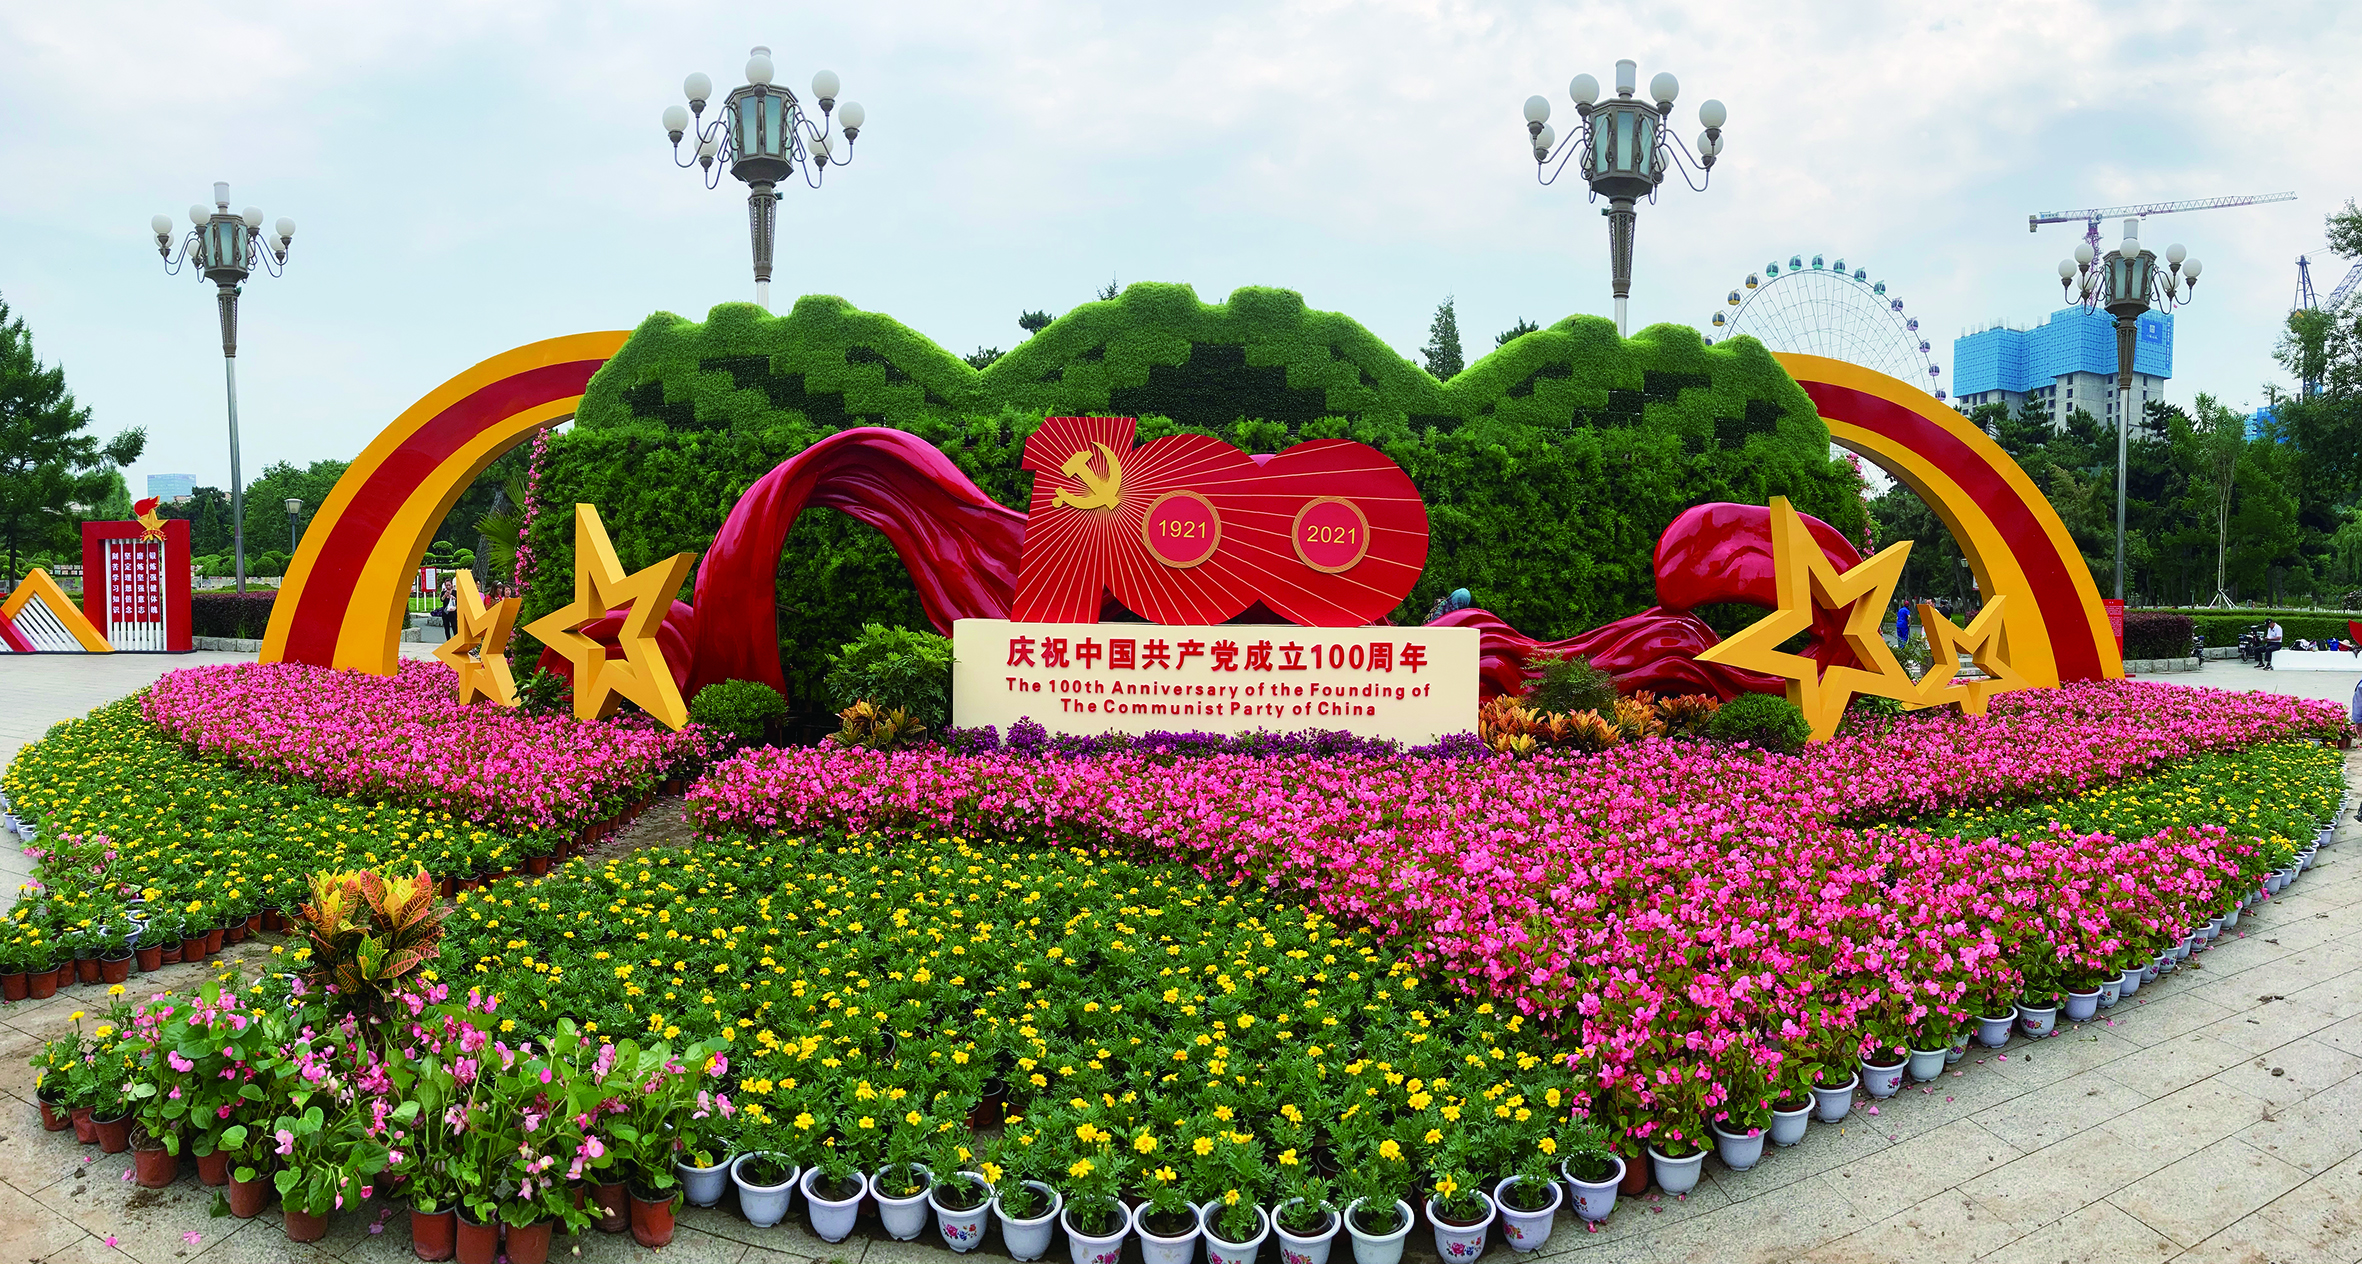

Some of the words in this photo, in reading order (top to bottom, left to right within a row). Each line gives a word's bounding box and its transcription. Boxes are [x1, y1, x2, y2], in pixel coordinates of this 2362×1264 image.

[1157, 519, 1207, 539] 1921
[1306, 525, 1356, 545] 2021
[112, 552, 120, 614] 刻苦学习知识
[124, 552, 133, 614] 坚定理想信念
[1006, 634, 1428, 674] 庆祝中国共产党成立100周年
[1005, 676, 1041, 693] The
[1048, 678, 1105, 695] 100th
[1111, 680, 1239, 700] Anniversary
[1244, 682, 1265, 697] of
[1270, 682, 1304, 697] the
[1309, 682, 1405, 701] Founding
[1411, 683, 1431, 698] of
[1060, 697, 1097, 714] The
[1103, 698, 1224, 716] Communist
[1230, 701, 1285, 719] Party
[1291, 701, 1312, 716] of
[1317, 700, 1376, 717] China
